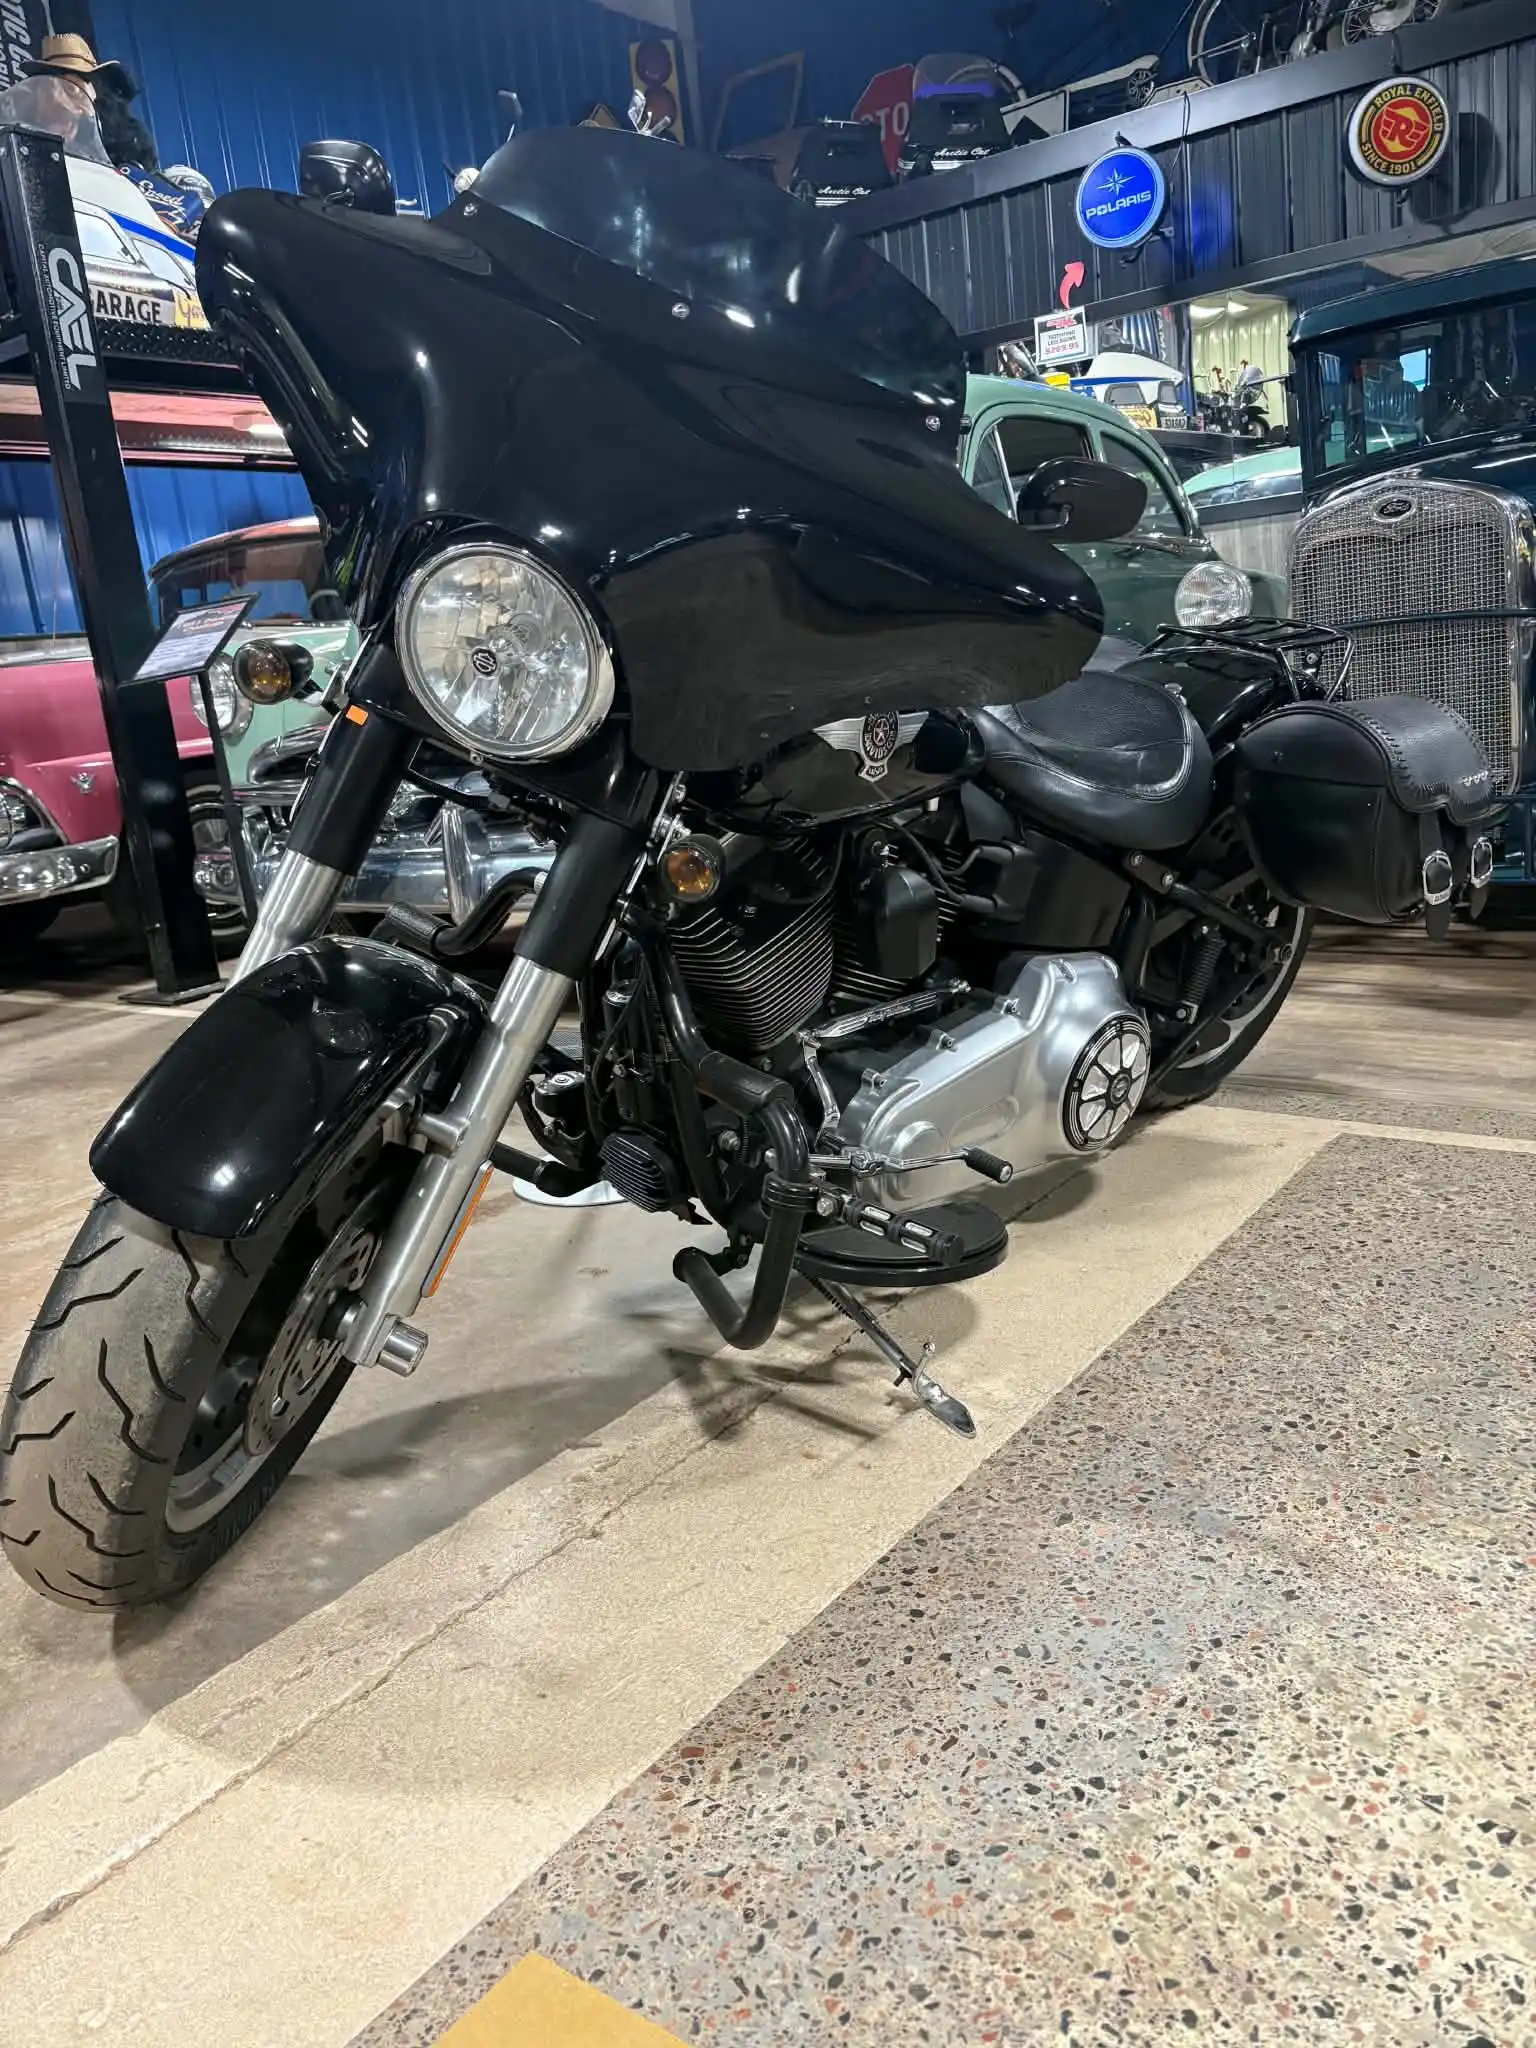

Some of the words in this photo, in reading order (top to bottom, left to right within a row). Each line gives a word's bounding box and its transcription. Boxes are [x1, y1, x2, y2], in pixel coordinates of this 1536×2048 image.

[1374, 84, 1413, 108] ROYAL
[1414, 86, 1444, 131] ENFIELD
[1362, 142, 1389, 172] SINCE
[1388, 161, 1417, 175] 1901
[1085, 190, 1153, 219] POLARIS
[48, 248, 97, 390] CAEL
